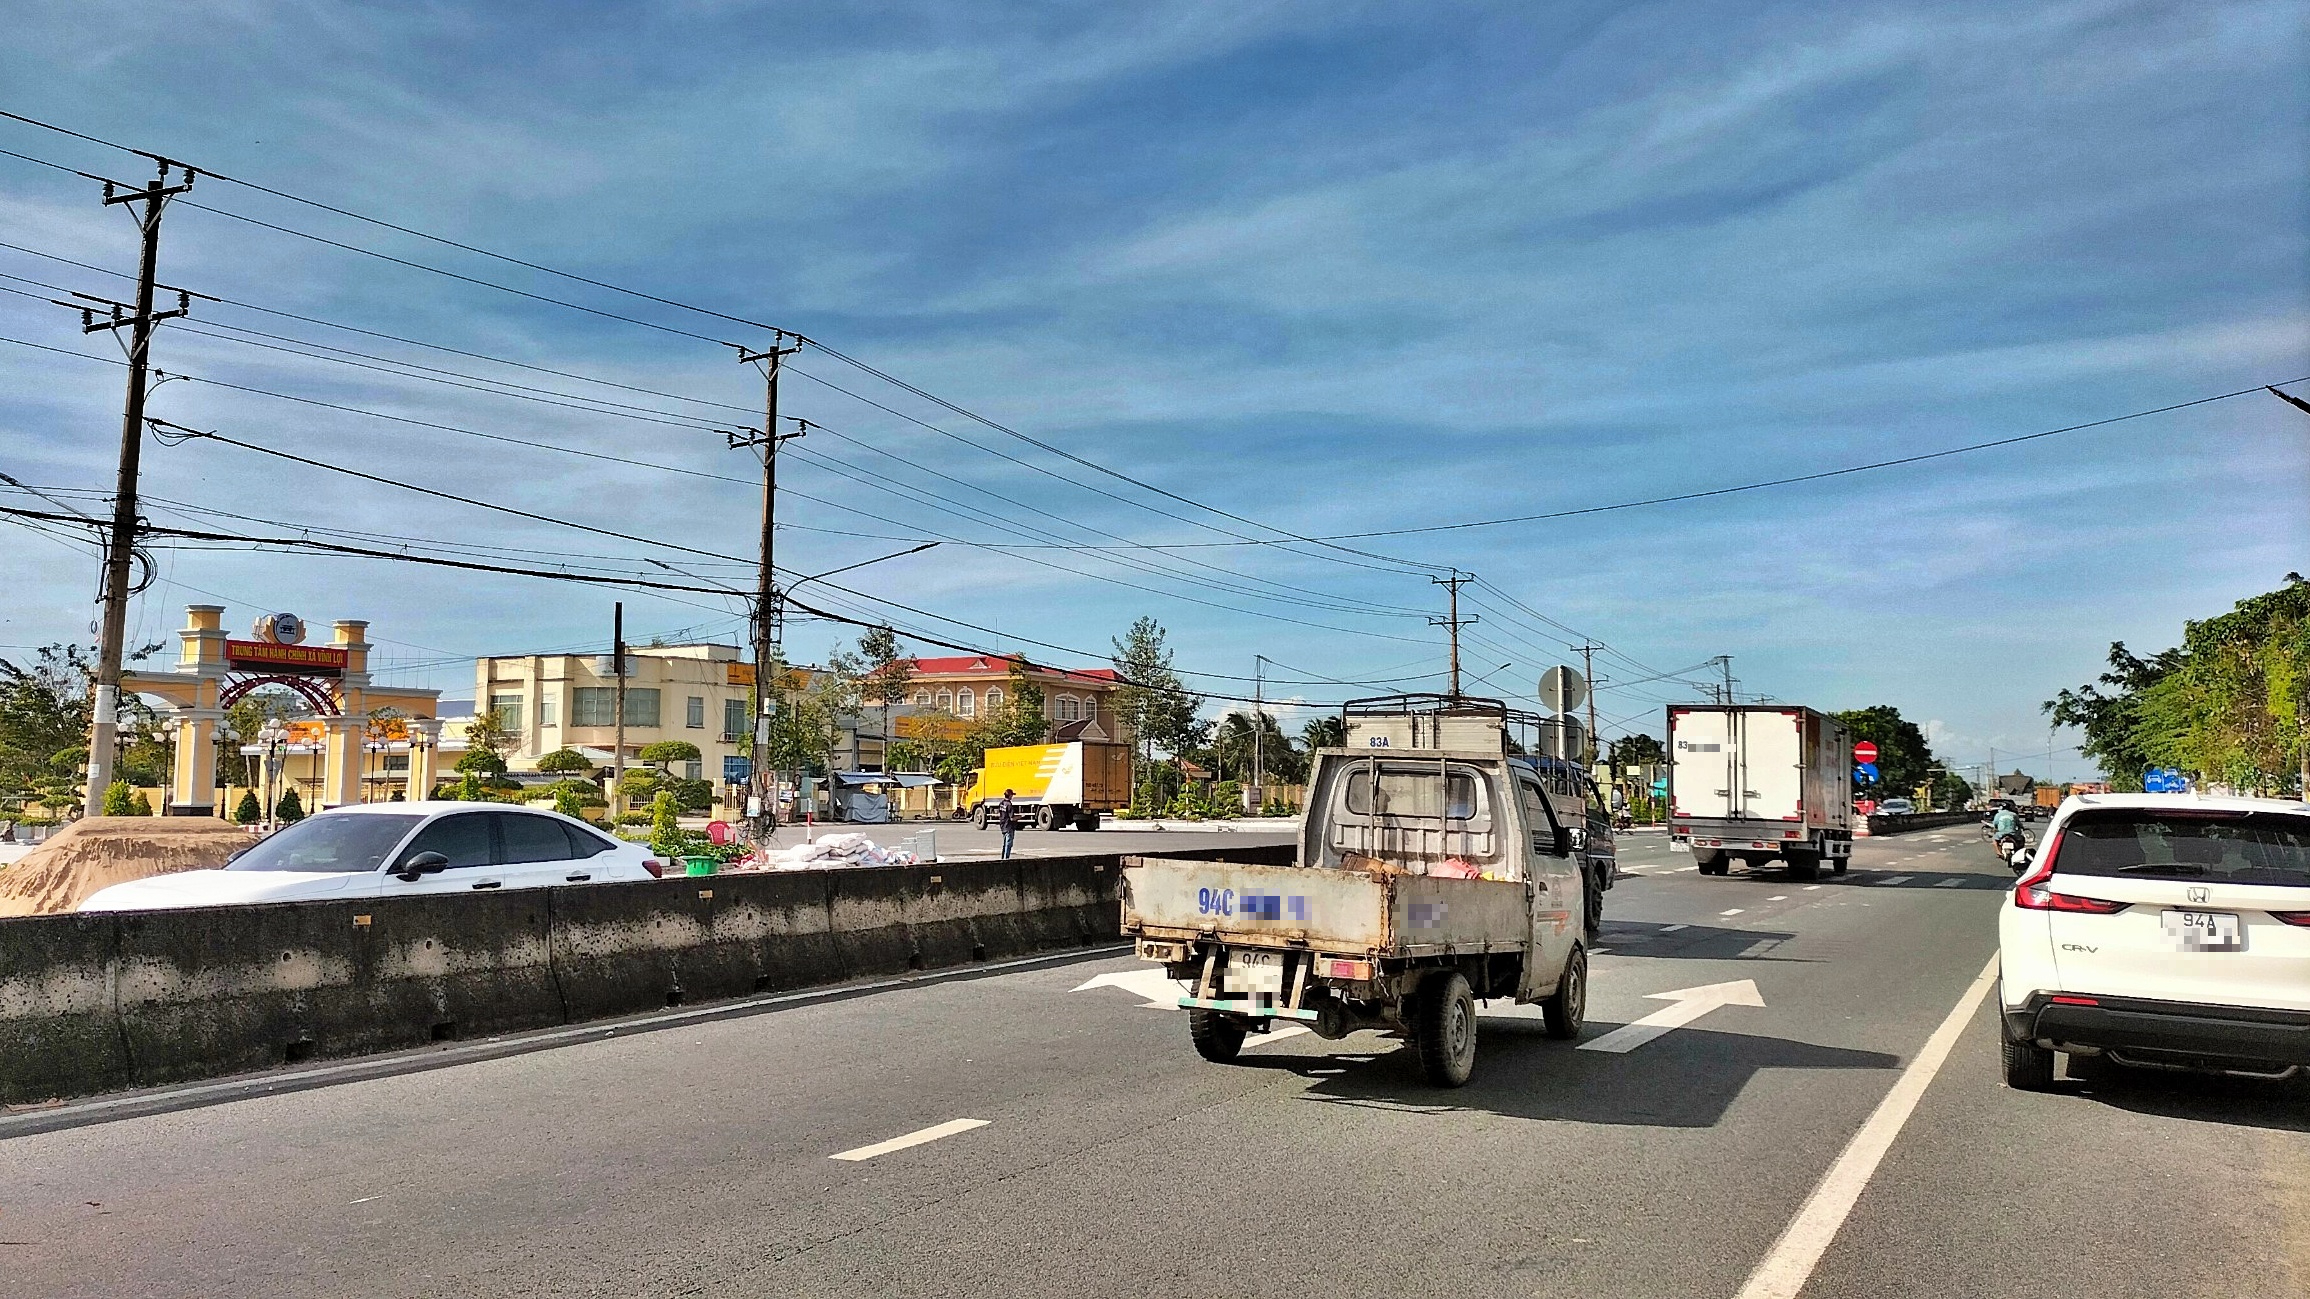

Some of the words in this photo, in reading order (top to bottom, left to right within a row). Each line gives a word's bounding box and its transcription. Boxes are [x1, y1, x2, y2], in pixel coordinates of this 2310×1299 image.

[231, 644, 253, 657] TRUNG
[254, 644, 268, 659] TÂM
[269, 645, 287, 661] HÀNH
[287, 646, 307, 661] CHÍNH
[307, 648, 317, 662] XÃ
[317, 649, 332, 664] VĨNH
[333, 651, 344, 666] LỢI
[1370, 736, 1389, 747] 83A
[1198, 887, 1234, 917] 94C
[2183, 913, 2217, 929] 94A
[2061, 943, 2099, 954] CR-V
